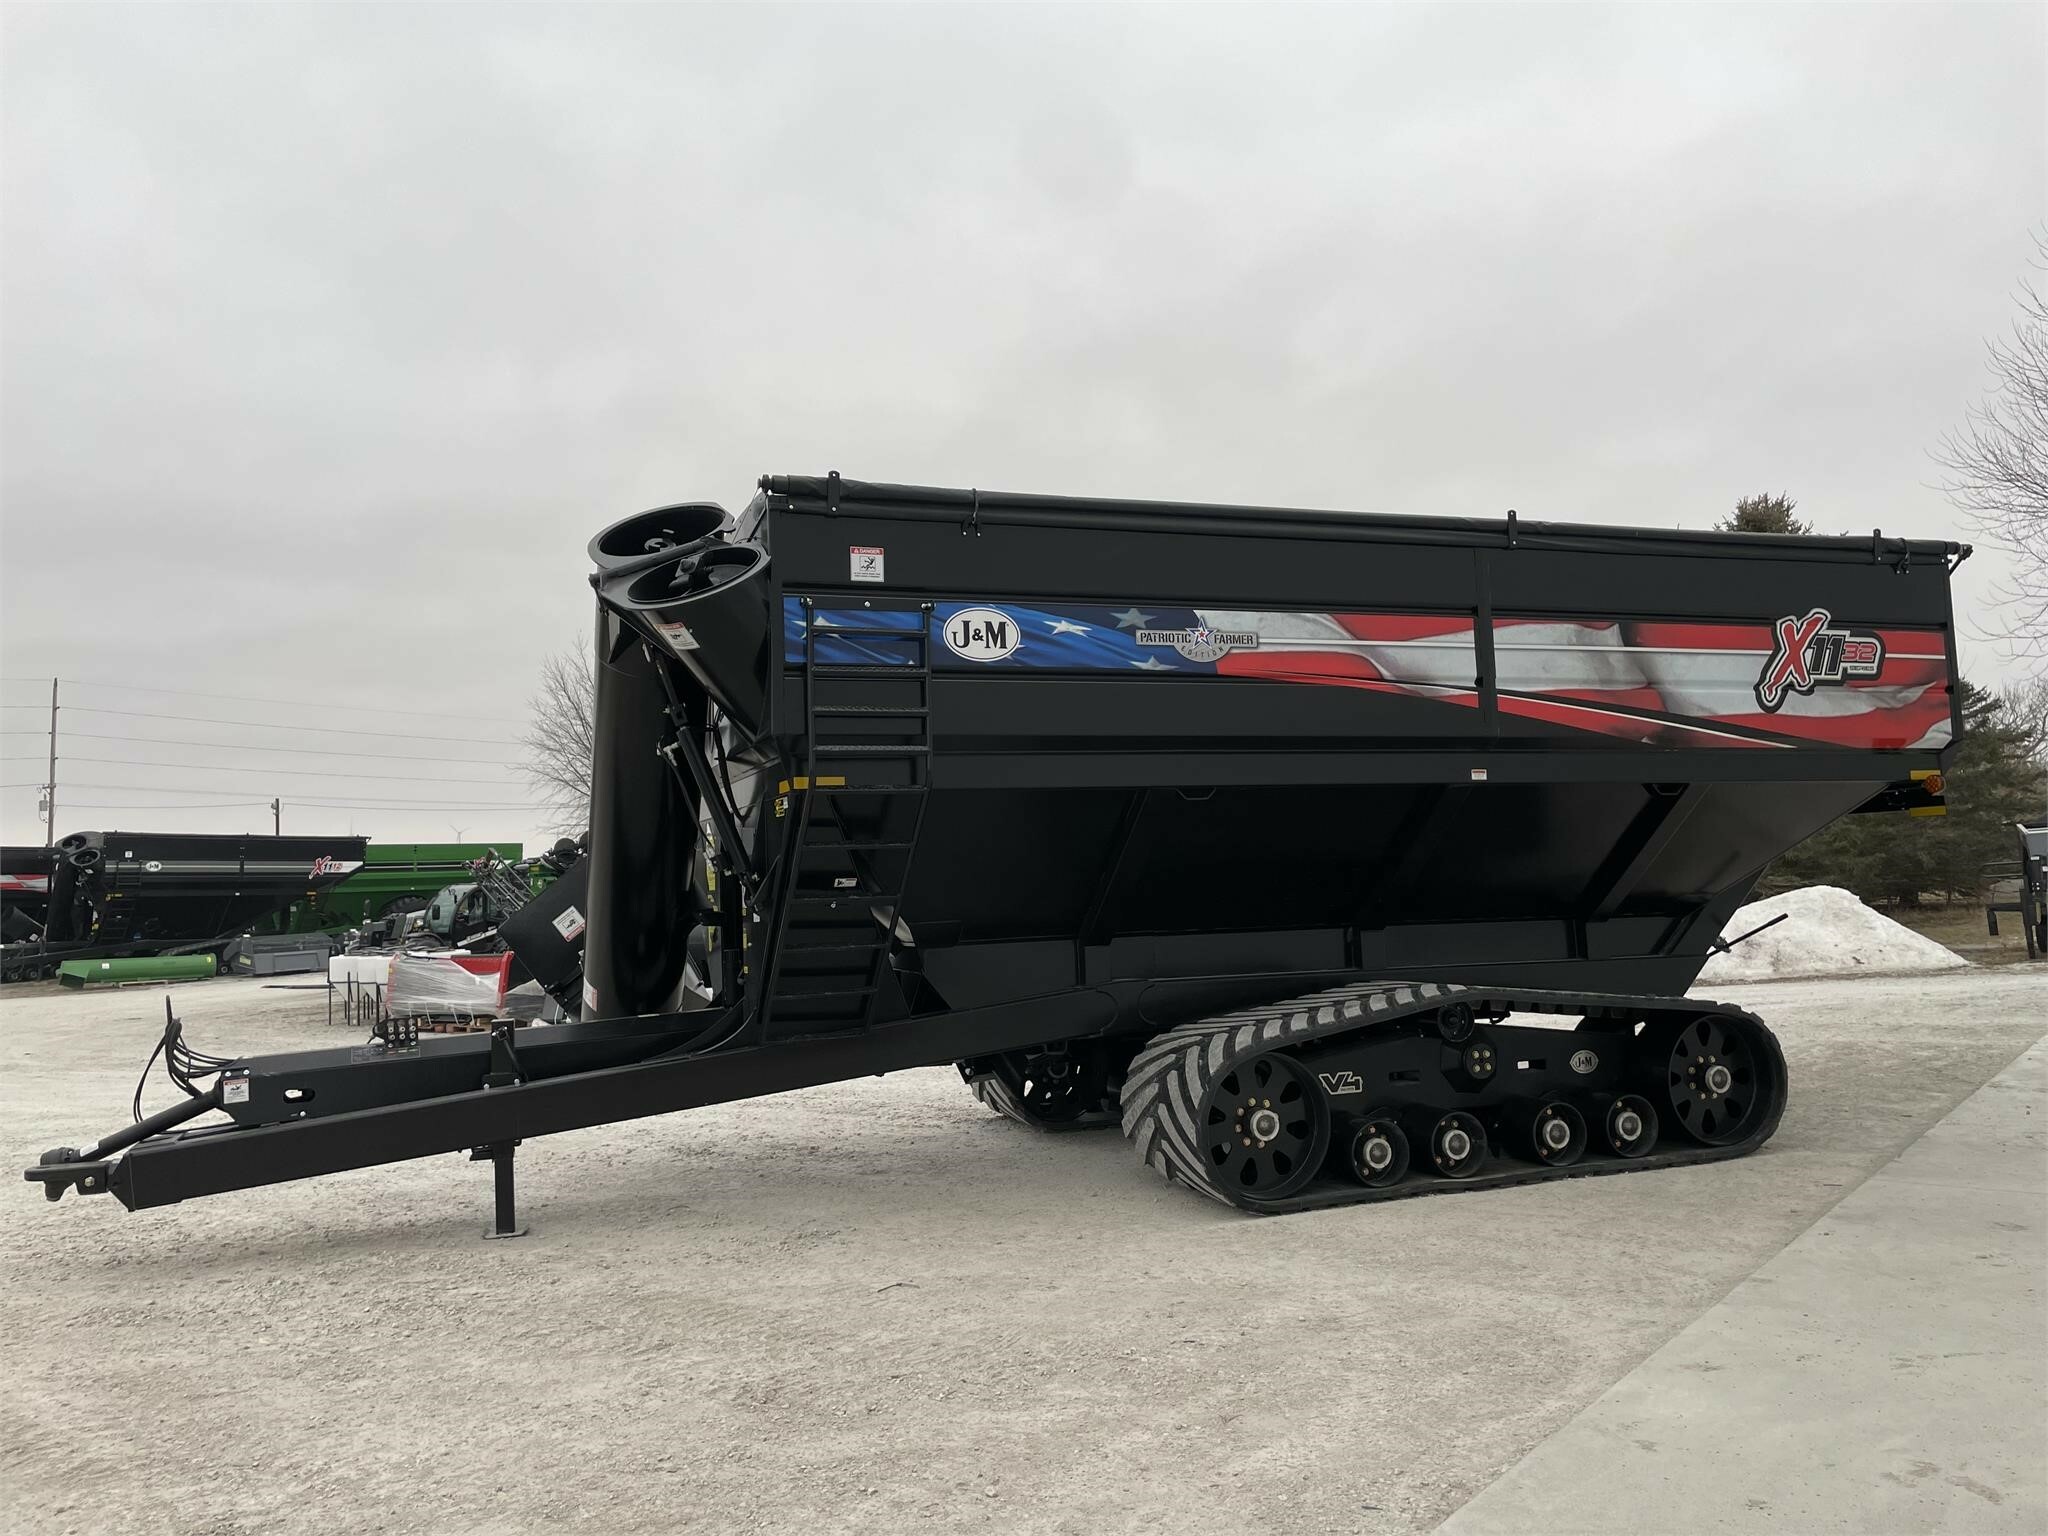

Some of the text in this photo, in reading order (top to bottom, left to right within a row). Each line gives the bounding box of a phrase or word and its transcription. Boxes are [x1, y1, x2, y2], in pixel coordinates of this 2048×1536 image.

[951, 620, 1007, 649] J&M
[1140, 632, 1254, 646] PATRIOTIC FARMER
[1181, 645, 1224, 658] EDITION
[1319, 1072, 1362, 1094] V4
